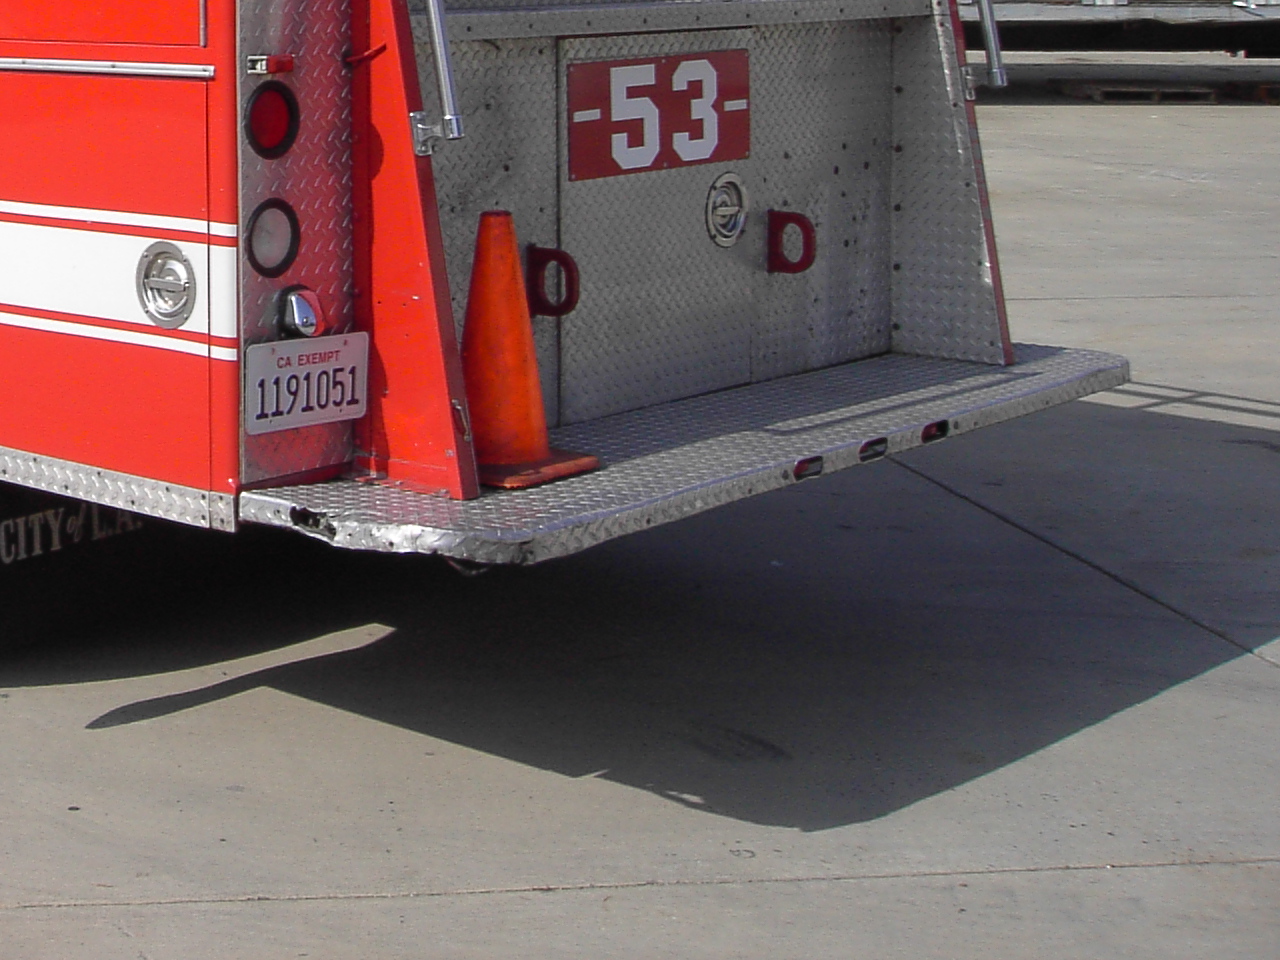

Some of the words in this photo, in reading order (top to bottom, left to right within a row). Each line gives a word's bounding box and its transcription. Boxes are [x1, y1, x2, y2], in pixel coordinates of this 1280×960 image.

[276, 356, 292, 368] CA
[297, 350, 342, 367] EXEMPT
[255, 366, 359, 420] 1191051
[66, 501, 87, 543] of
